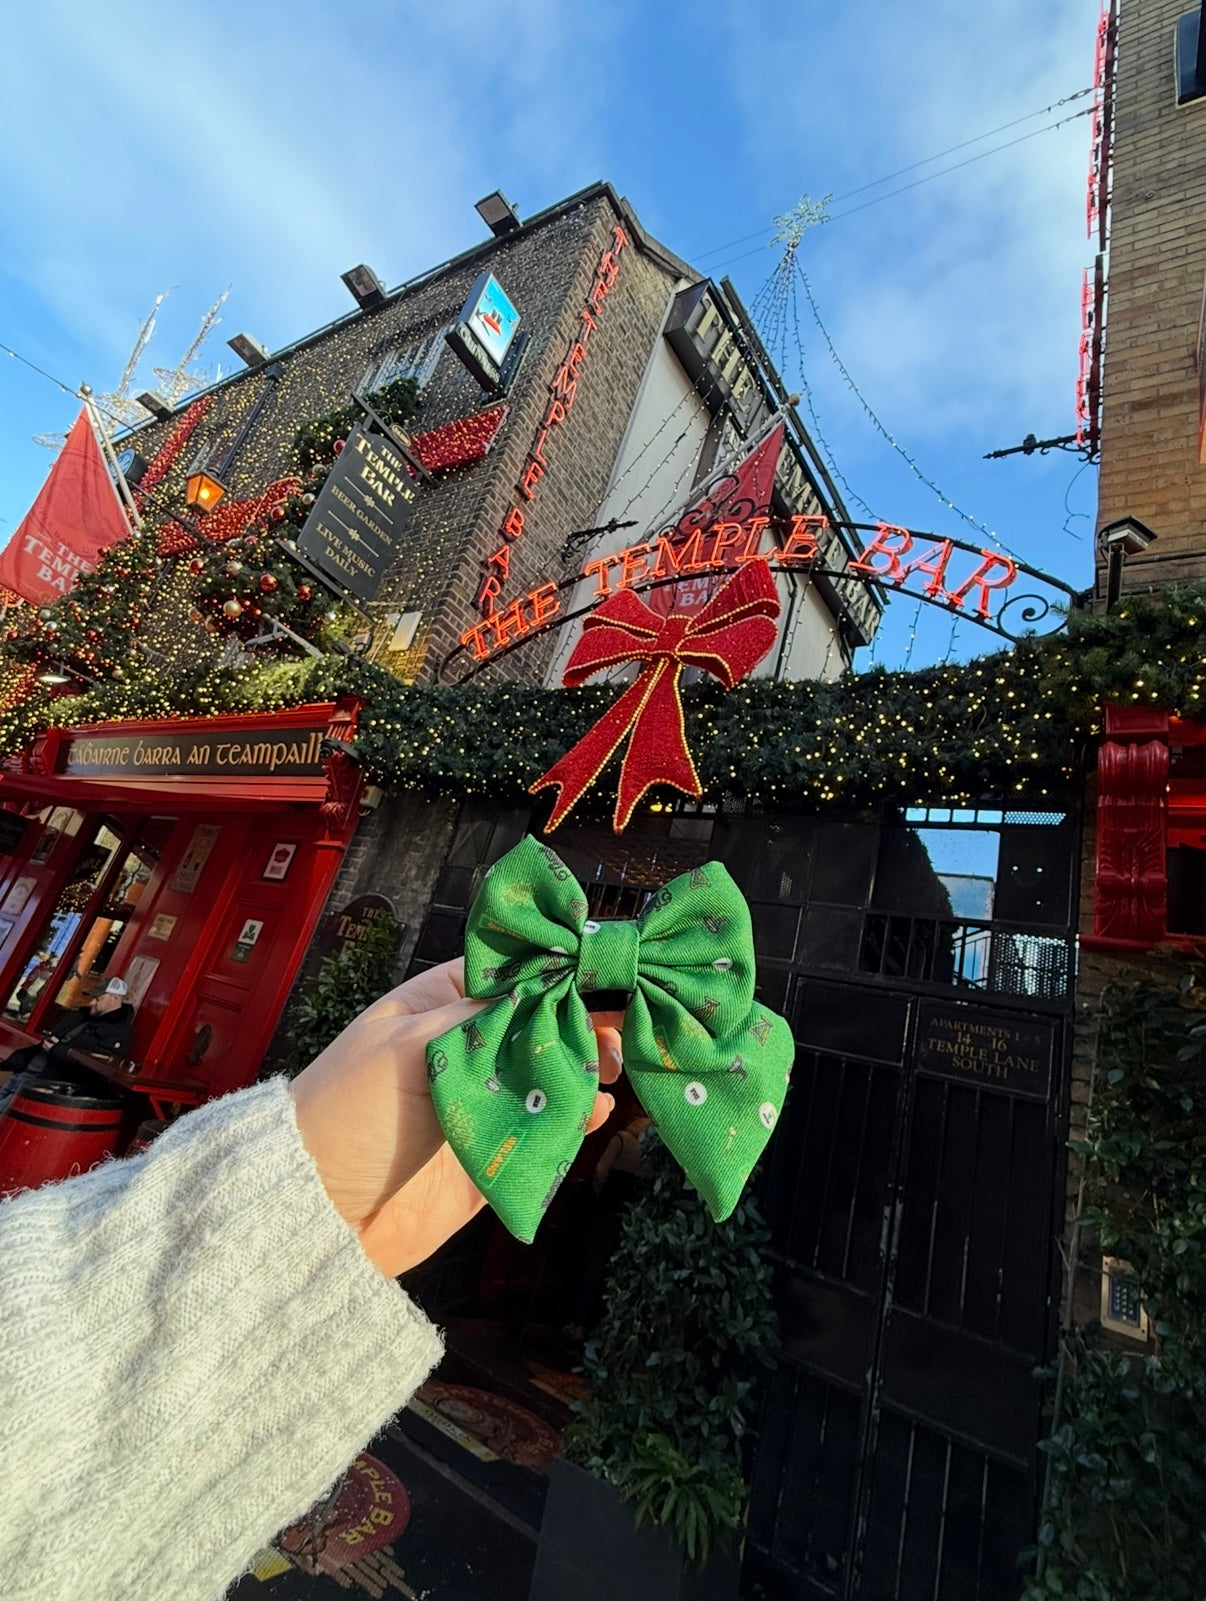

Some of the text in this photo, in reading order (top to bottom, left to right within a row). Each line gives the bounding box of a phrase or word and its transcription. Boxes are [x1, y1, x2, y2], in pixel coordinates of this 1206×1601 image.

[592, 226, 630, 314] THE
[459, 326, 501, 384] GUINNESS
[523, 310, 598, 500] TEMPLE
[354, 432, 416, 505] TEMPLE
[380, 444, 403, 472] THE
[360, 463, 396, 508] BAR
[330, 484, 394, 546] BEER GARDEN
[56, 542, 92, 575] THE
[315, 521, 377, 578] LIVE MUSIC
[324, 545, 360, 578] DAILY
[479, 506, 525, 617] BAR
[460, 514, 1018, 661] THE TEMPLE BAR
[930, 1017, 1010, 1038] APARTMENTS
[956, 1030, 1008, 1053] 14 16
[928, 1038, 1040, 1073] TEMPLE LANE
[952, 1055, 1008, 1079] SOUTH
